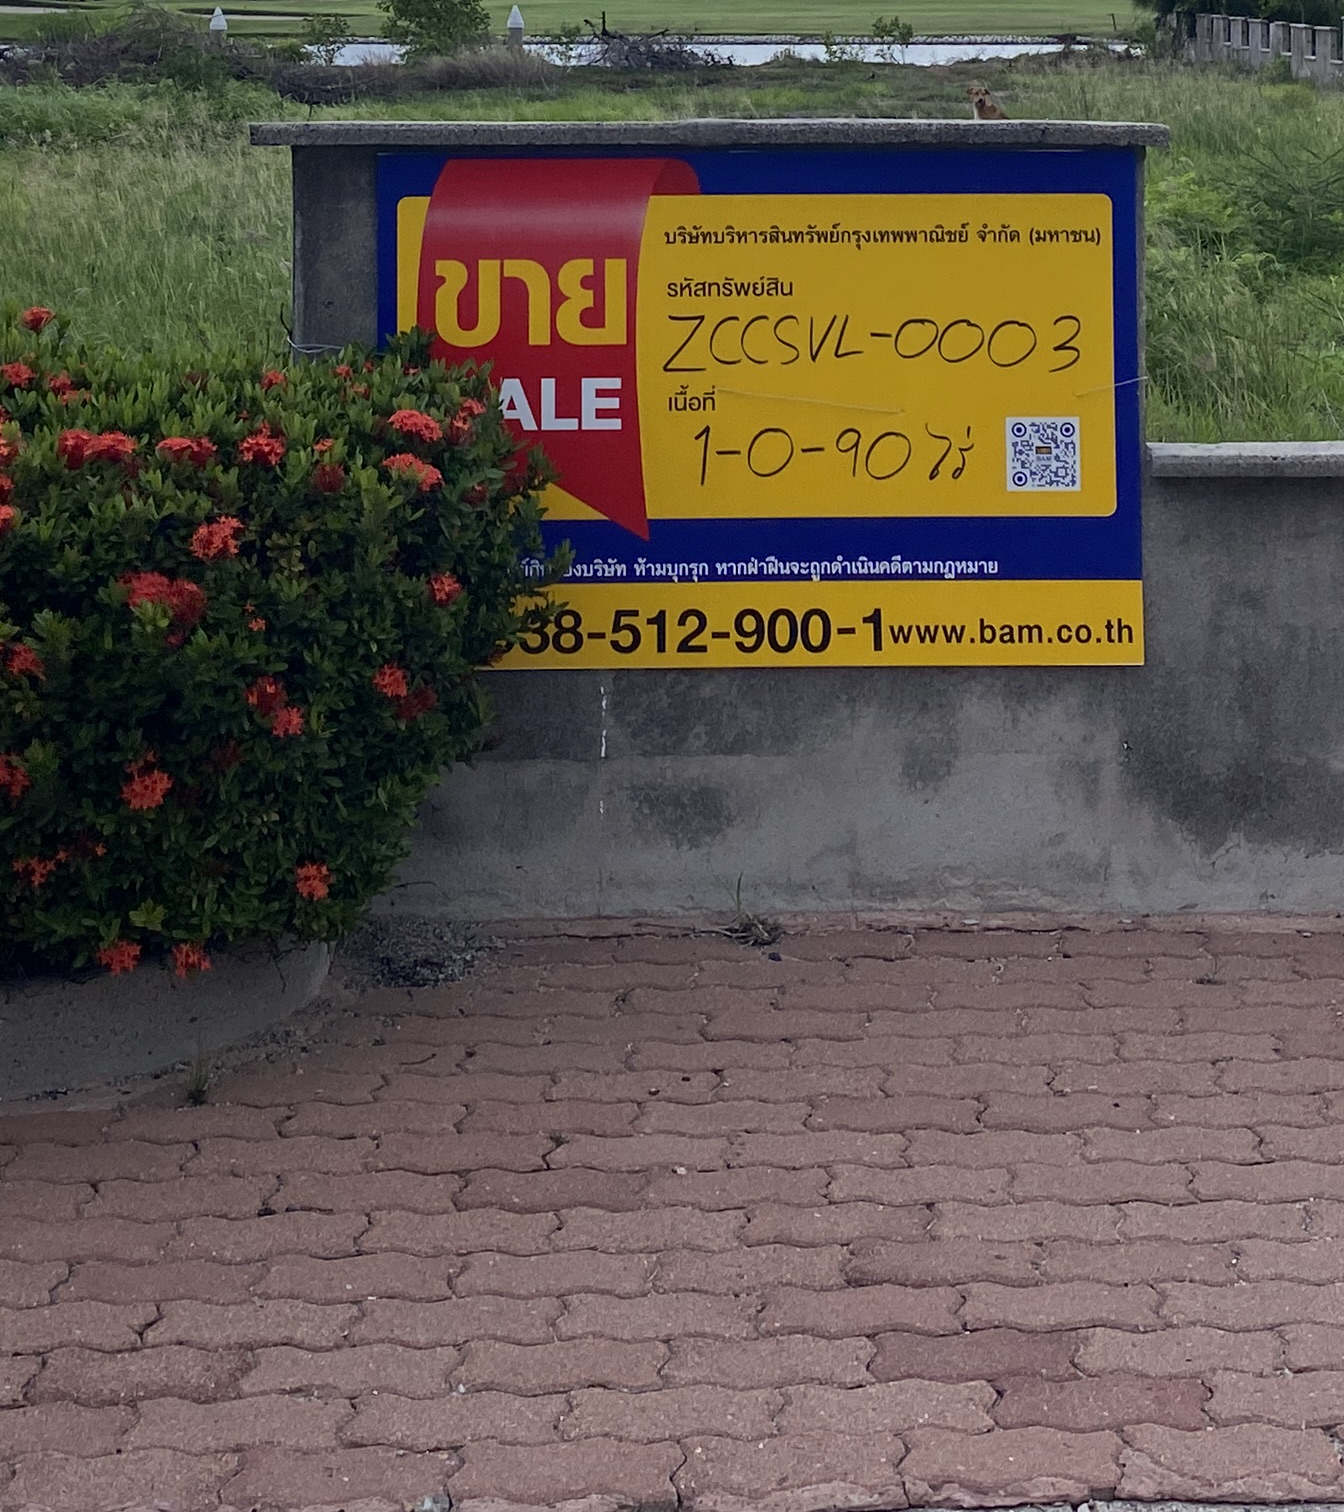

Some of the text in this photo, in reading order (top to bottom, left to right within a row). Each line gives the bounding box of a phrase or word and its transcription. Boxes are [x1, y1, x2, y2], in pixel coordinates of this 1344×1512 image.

[664, 222, 1101, 250] บริษัทบริหารสินทรัพย์กรุงเทพพาณิชย์ จำกัด (มหาชน)
[666, 276, 793, 297] รหัสทรัพย์สิน
[435, 258, 627, 348] ขาย
[498, 377, 622, 431] ALE
[668, 385, 716, 412] เนื้อที่
[633, 557, 709, 582] ห้ามบุกรุก
[715, 555, 999, 581] หากฝ่าฝืนจะถูกดำเนินคดีตามกฎหมาย
[888, 618, 1134, 644] www.bam.co.th
